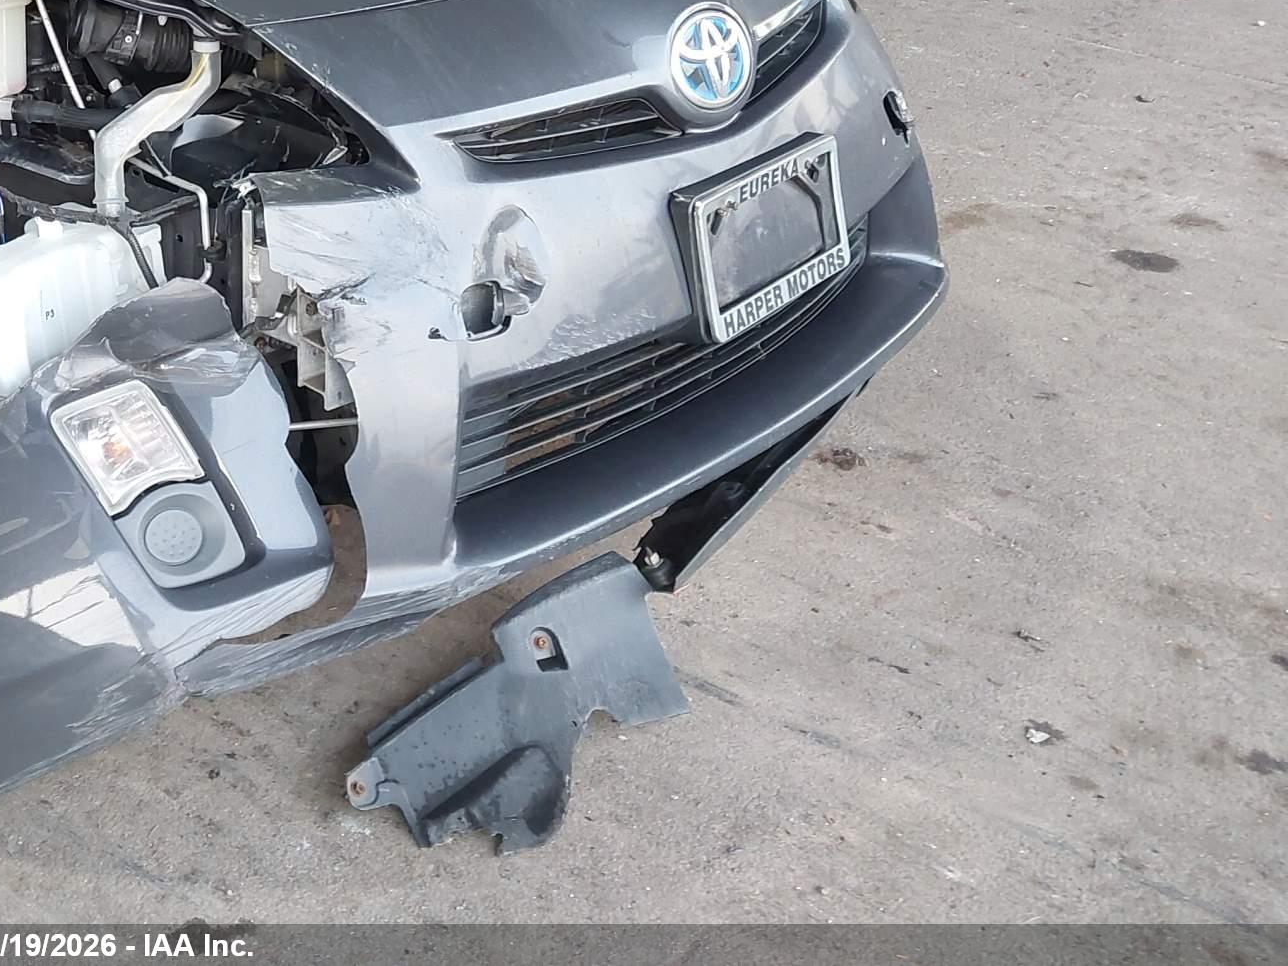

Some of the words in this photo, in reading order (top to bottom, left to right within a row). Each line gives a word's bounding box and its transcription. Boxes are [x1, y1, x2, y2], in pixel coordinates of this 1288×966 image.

[739, 157, 800, 204] EUREKA
[723, 285, 785, 339] HARPER
[786, 247, 846, 300] MOTORS
